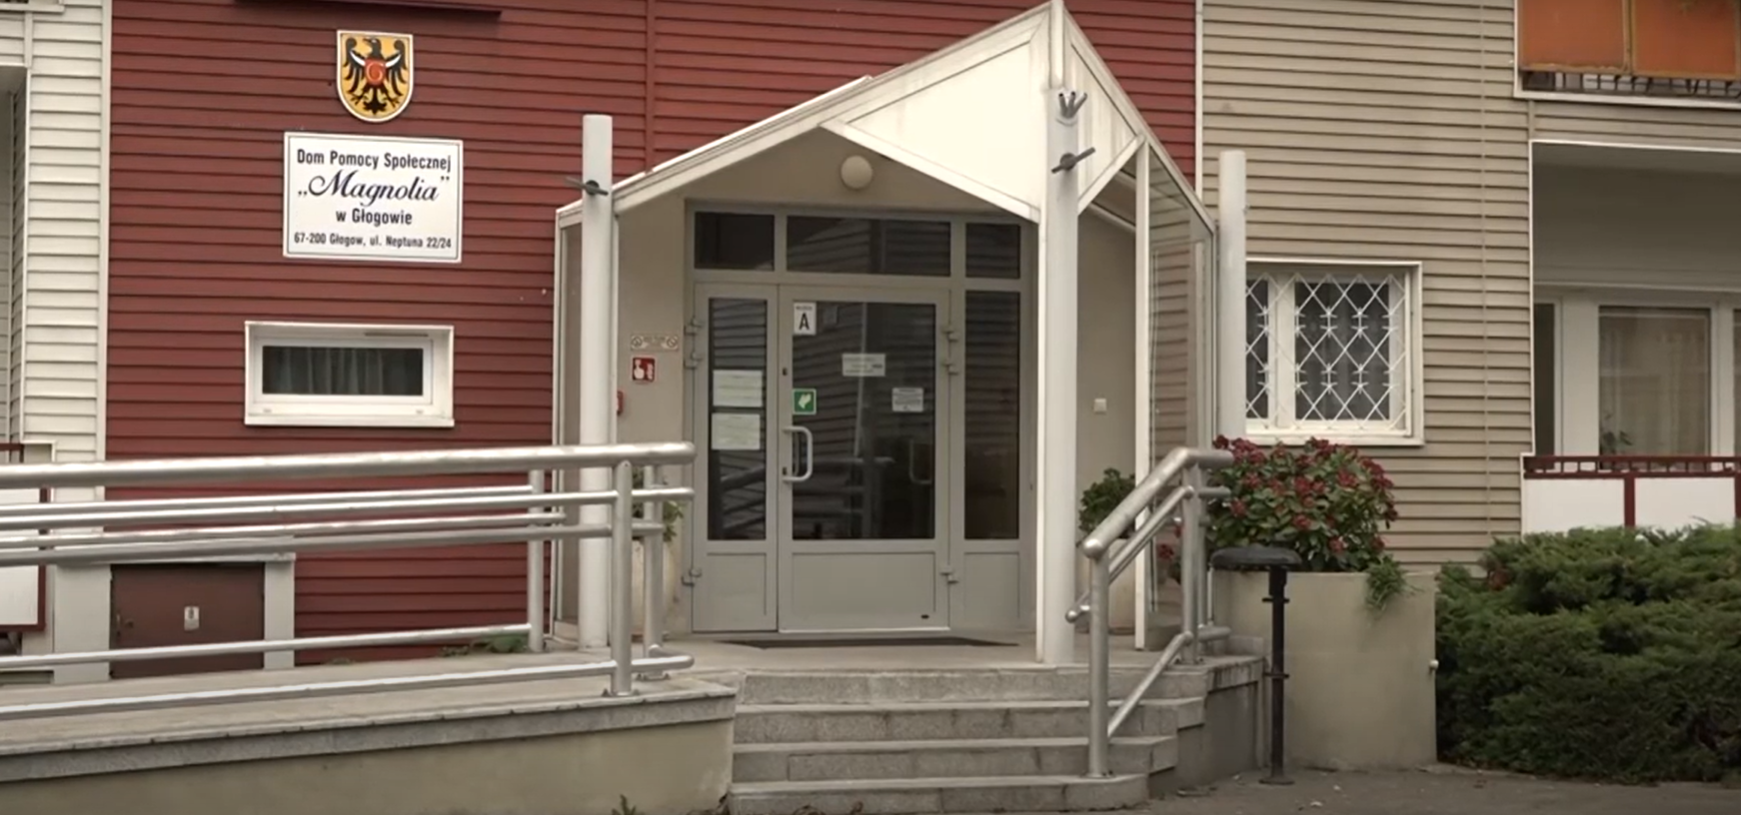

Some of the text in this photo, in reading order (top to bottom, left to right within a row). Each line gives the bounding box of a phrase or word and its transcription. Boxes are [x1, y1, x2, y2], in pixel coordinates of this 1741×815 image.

[297, 148, 451, 173] Dom Pomocy Społecznej
[336, 208, 413, 227] w Głogowie
[294, 232, 326, 244] 67-200
[370, 235, 382, 247] ul.
[386, 236, 423, 249] Neptuna
[426, 237, 452, 249] 22/24
[799, 312, 810, 330] A
